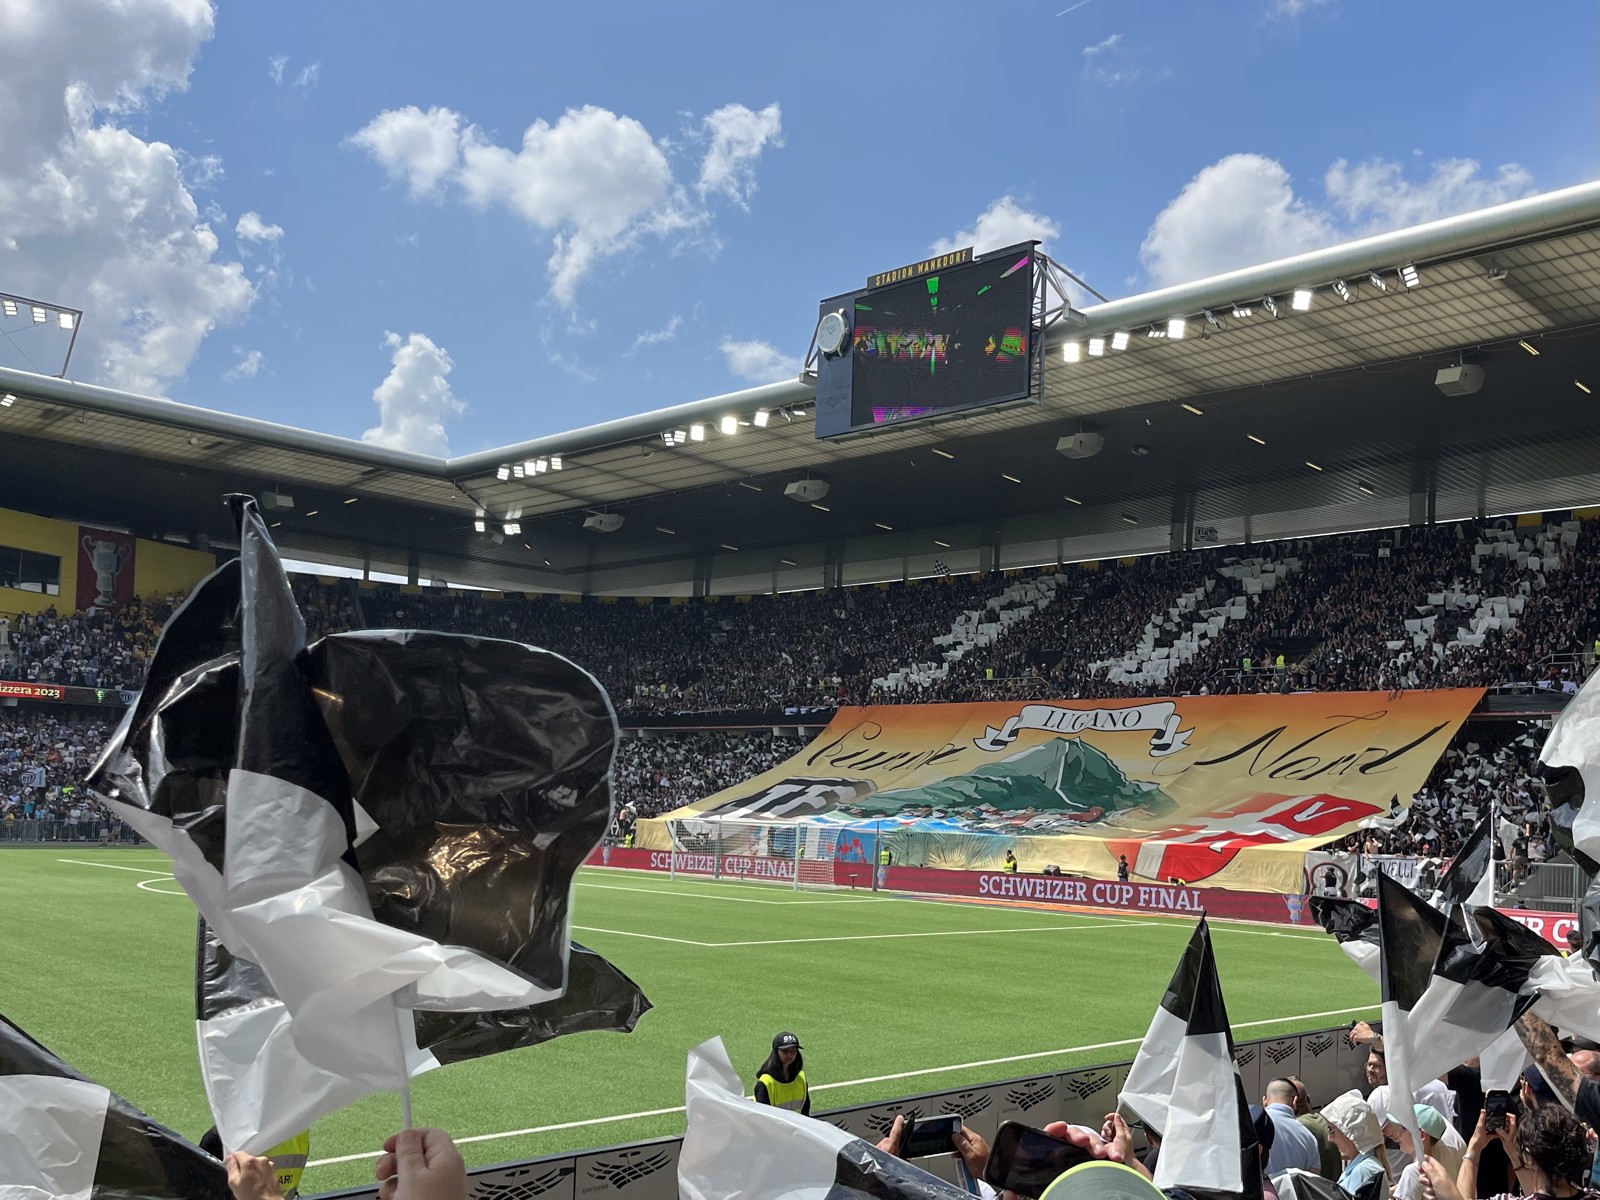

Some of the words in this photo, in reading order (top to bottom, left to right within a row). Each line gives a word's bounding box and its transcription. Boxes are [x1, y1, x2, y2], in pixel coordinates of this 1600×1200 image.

[875, 266, 913, 286] STADION
[917, 250, 967, 274] WANKDORF
[34, 688, 60, 699] 2023
[1042, 709, 1142, 731] LUGANO
[1152, 710, 1451, 780] Nord
[725, 857, 751, 876] CUP
[755, 860, 796, 879] FINAL
[1382, 860, 1415, 879] VELLI
[979, 875, 1088, 902] SCHWEIZER
[1092, 886, 1134, 906] CUP
[1138, 887, 1204, 912] FINAL
